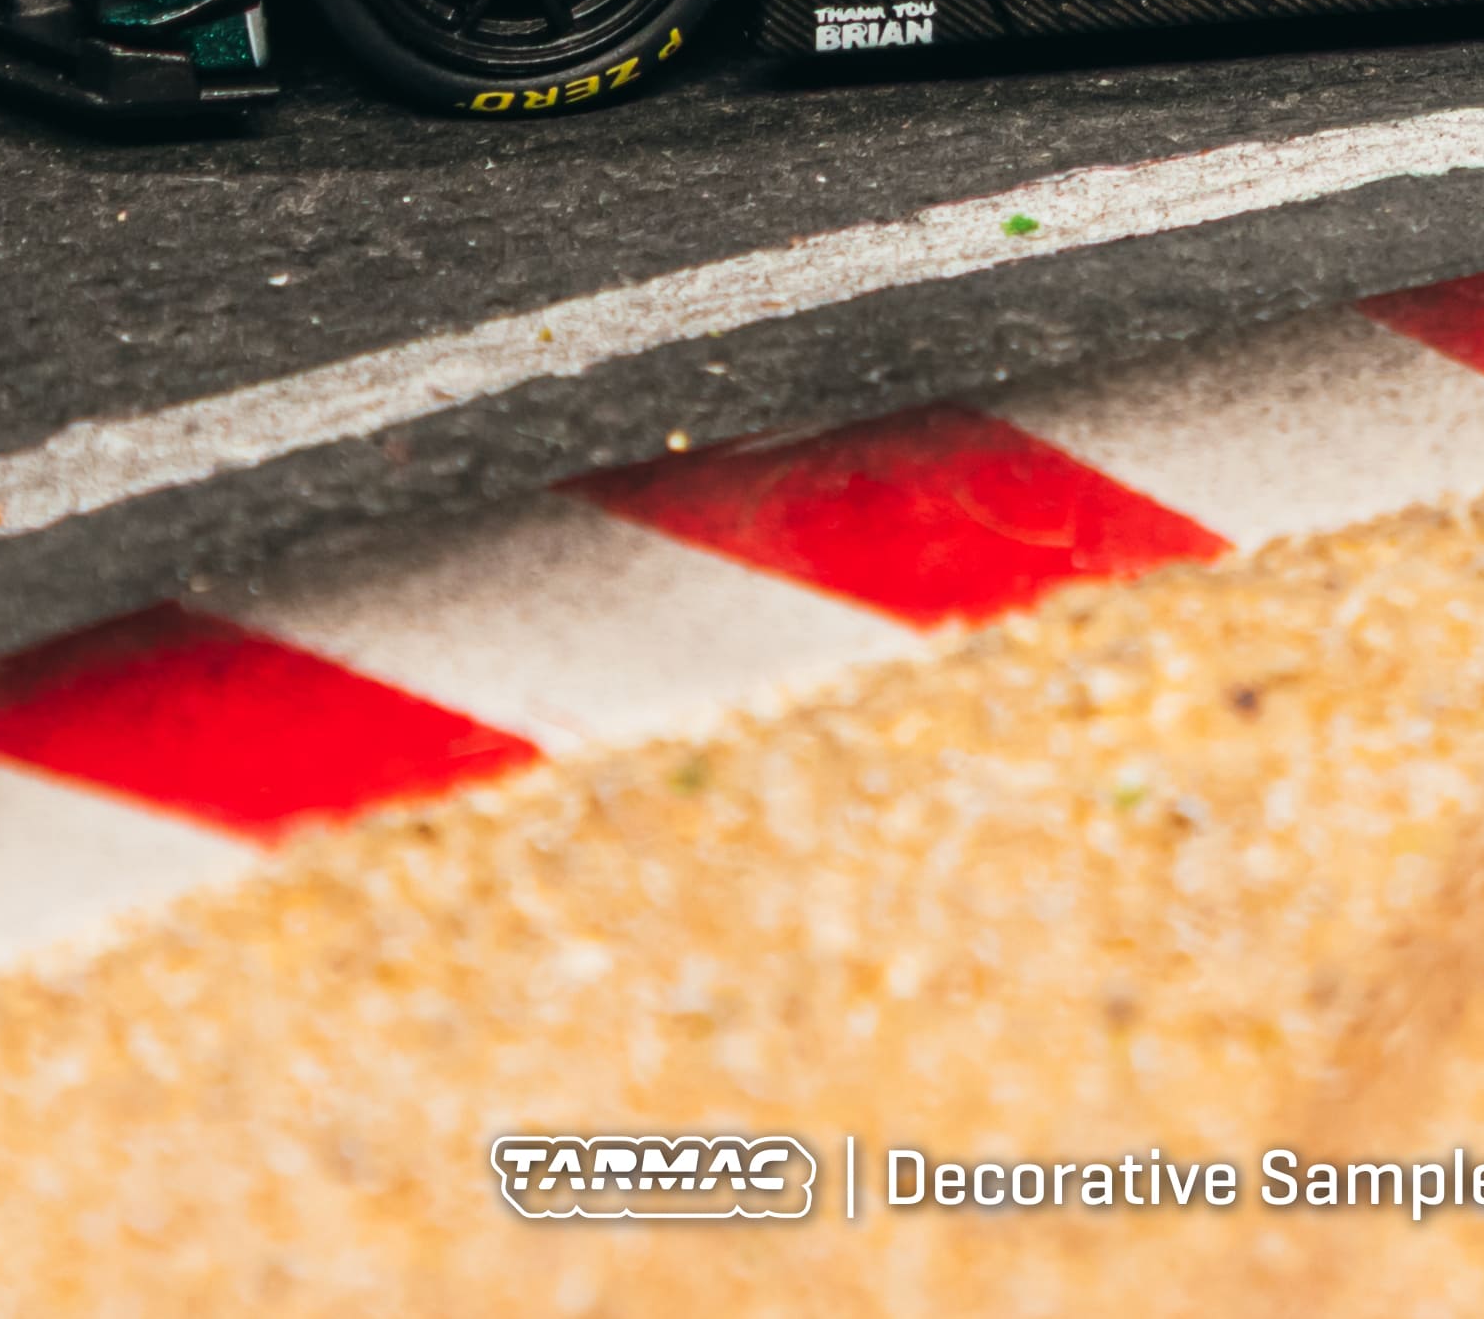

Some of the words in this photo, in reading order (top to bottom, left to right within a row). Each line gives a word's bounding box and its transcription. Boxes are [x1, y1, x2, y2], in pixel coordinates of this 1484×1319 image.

[892, 1, 937, 18] YOU
[816, 18, 934, 51] BRIAN
[469, 56, 641, 110] ZERO
